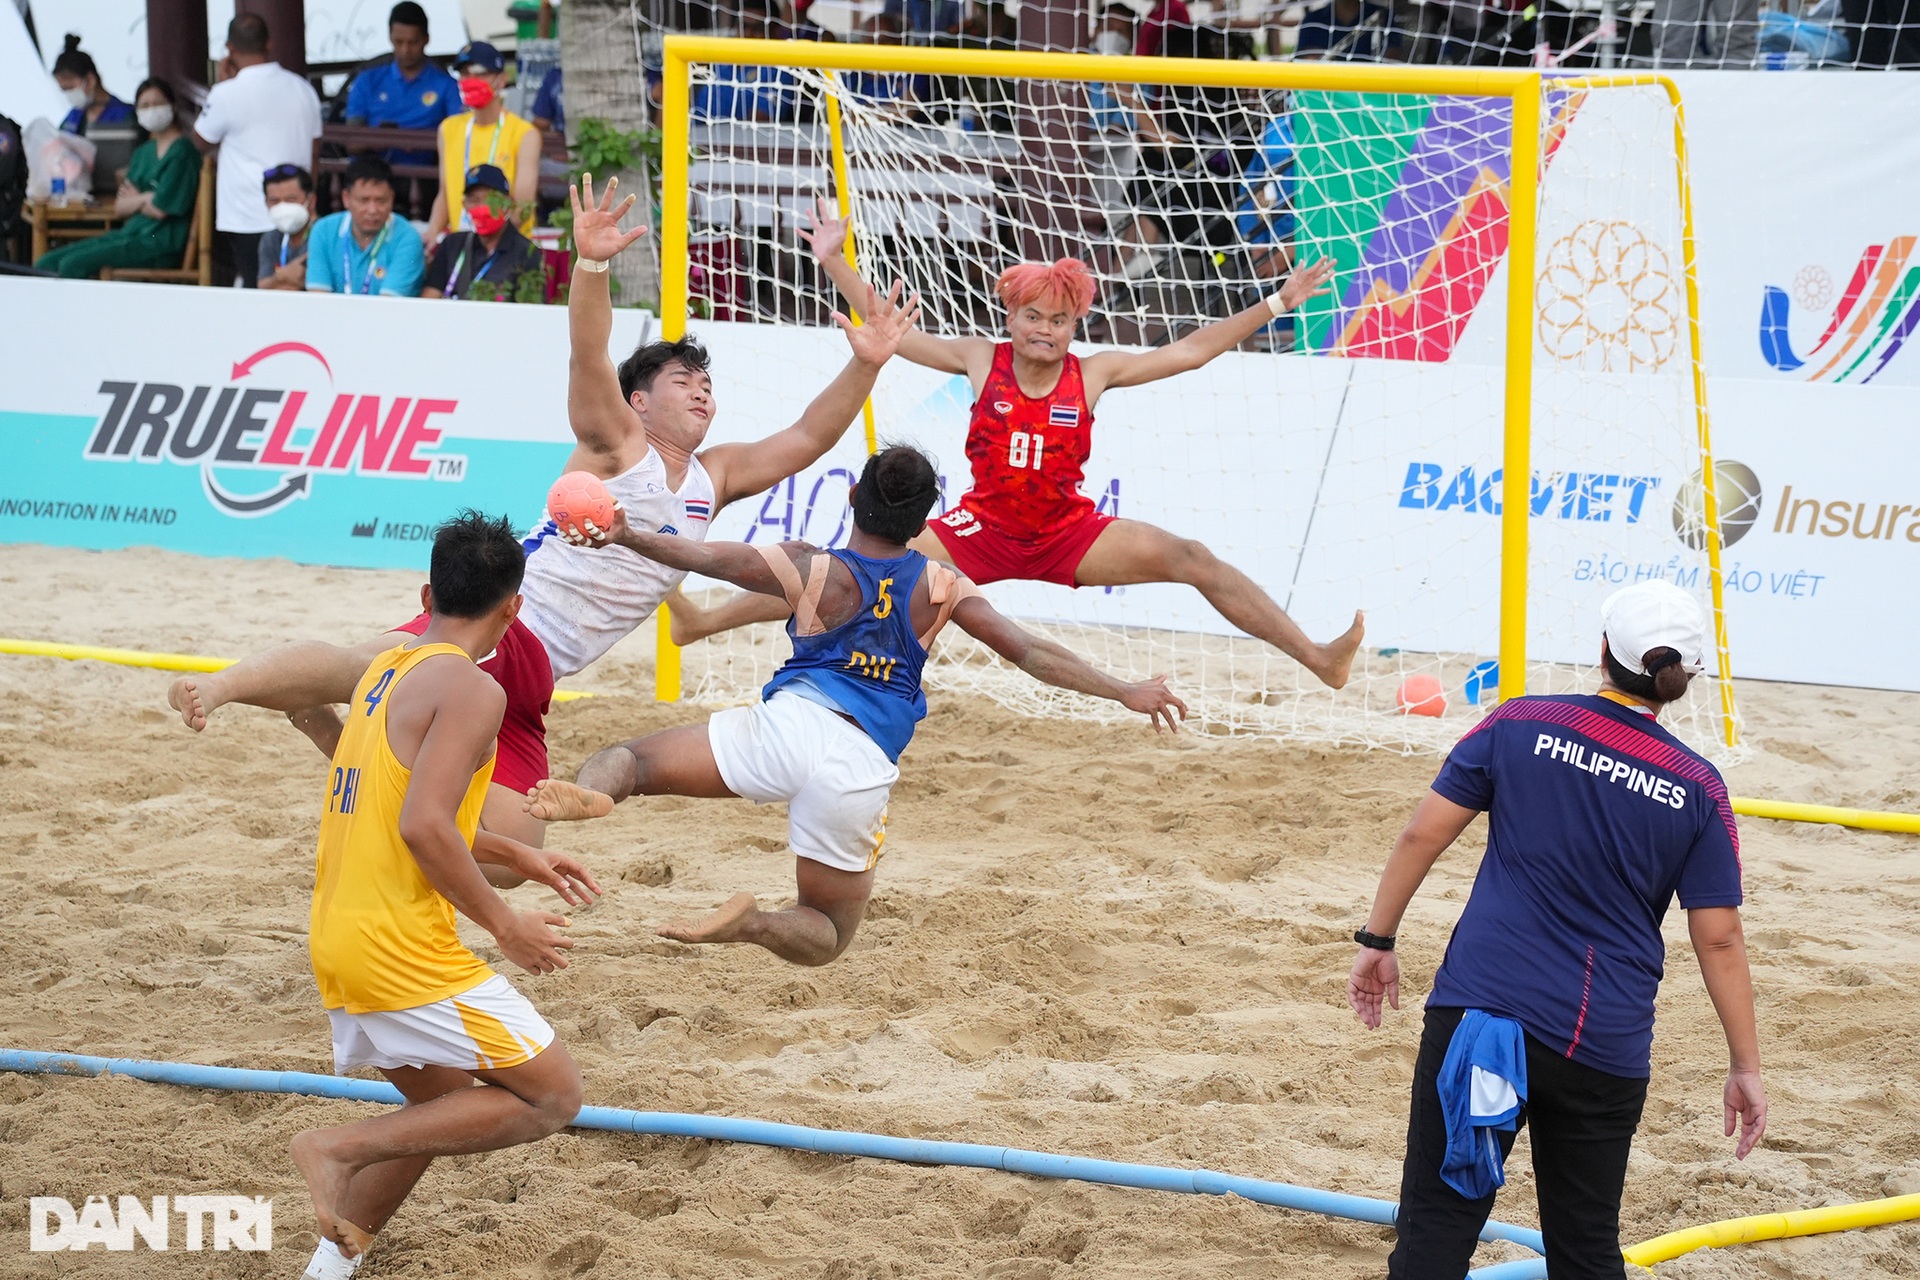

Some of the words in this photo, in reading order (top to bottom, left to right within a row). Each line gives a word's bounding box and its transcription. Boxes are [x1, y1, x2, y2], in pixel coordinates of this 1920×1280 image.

[89, 380, 460, 474] TRUELINE
[1008, 431, 1045, 470] 81
[101, 505, 121, 522] IN
[123, 506, 178, 526] HAND
[873, 578, 894, 619] 5
[1770, 569, 1826, 601] VIỆT
[364, 668, 396, 716] 4
[329, 766, 361, 814] PHI
[1534, 733, 1687, 810] PHILIPPINES
